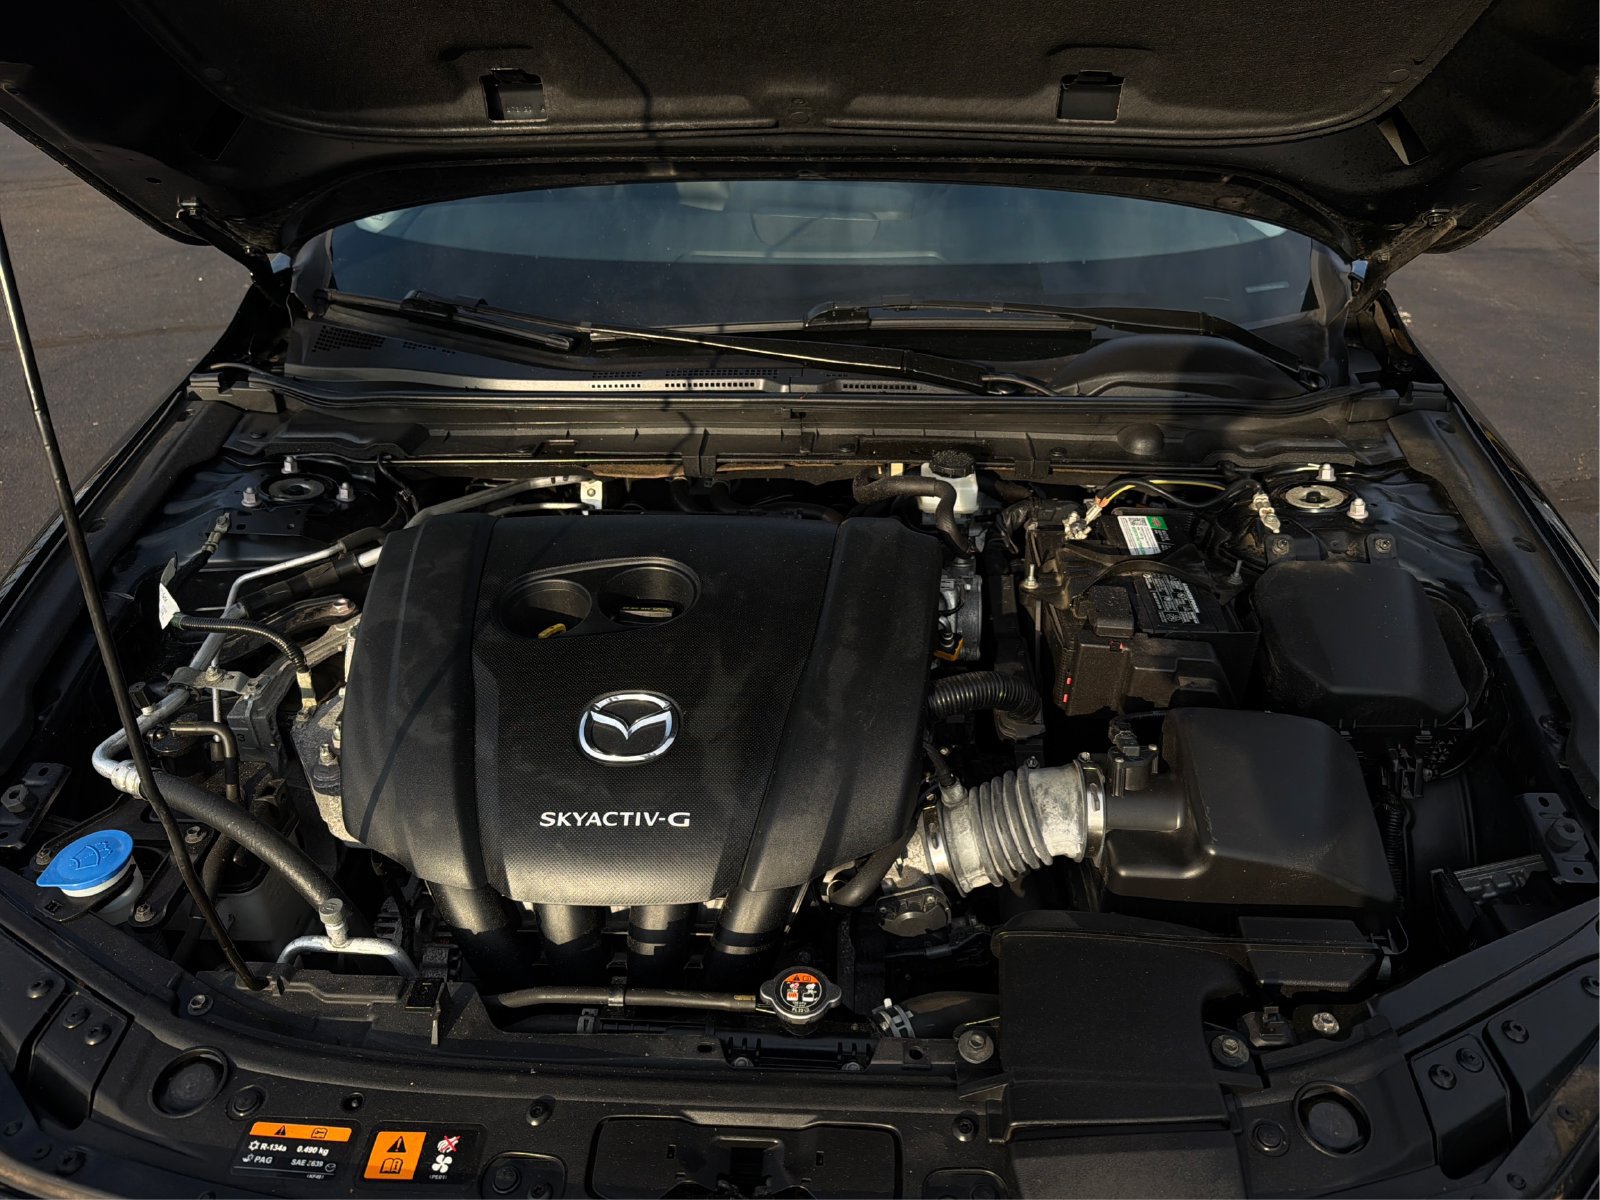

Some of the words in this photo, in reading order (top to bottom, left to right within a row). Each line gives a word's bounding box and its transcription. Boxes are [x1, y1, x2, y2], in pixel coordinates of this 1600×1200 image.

[539, 811, 691, 827] SKYACTIV-G
[260, 1142, 287, 1152] R-134a
[296, 1145, 318, 1153] 0.490
[318, 1147, 329, 1156] kg
[254, 1155, 272, 1164] PAG
[290, 1158, 306, 1166] SAE
